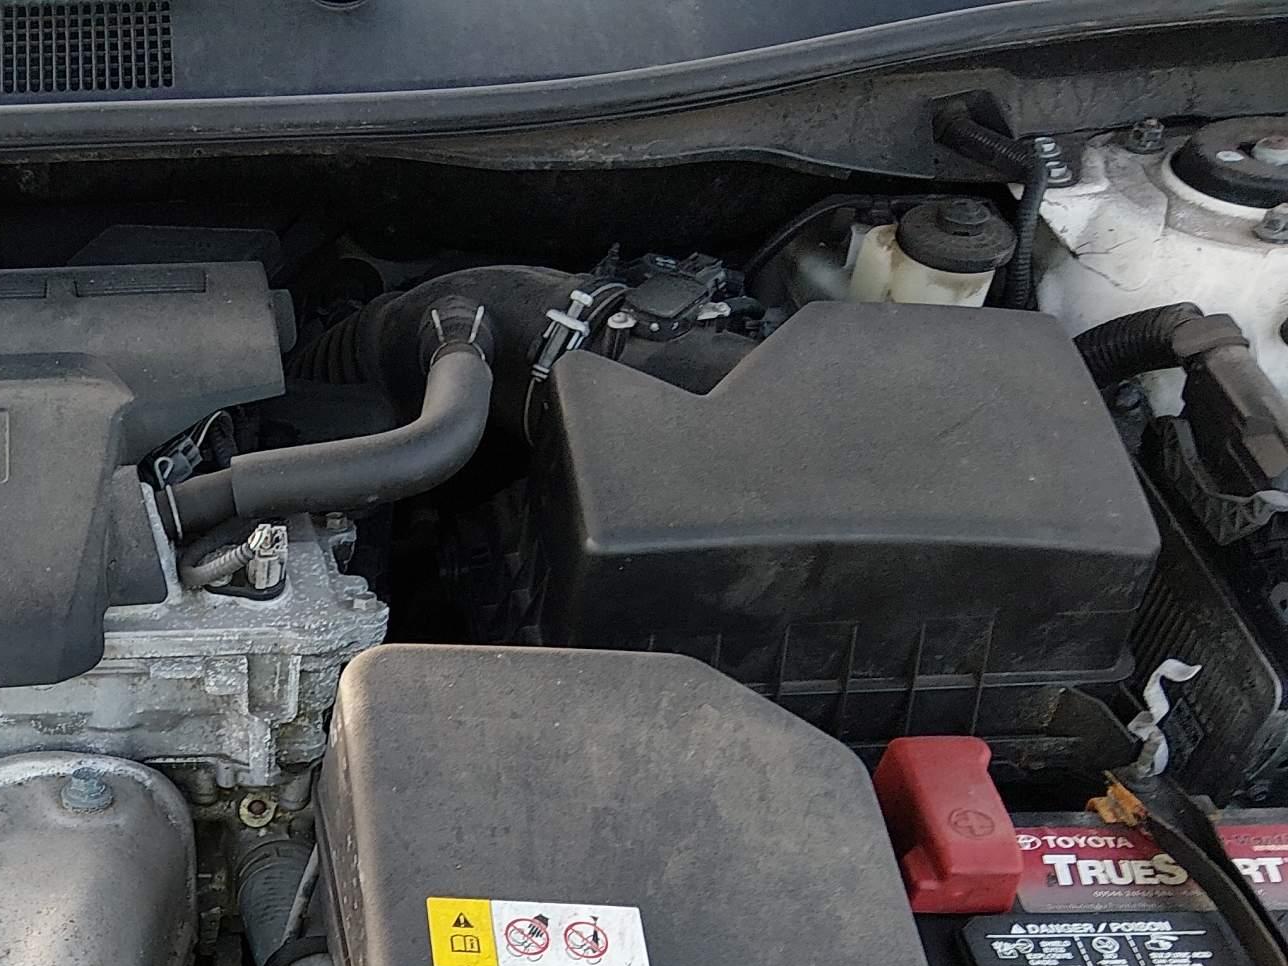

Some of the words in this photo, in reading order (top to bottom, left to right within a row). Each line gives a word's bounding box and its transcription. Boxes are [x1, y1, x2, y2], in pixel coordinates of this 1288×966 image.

[1043, 835, 1134, 849] TOYOTA
[1027, 922, 1095, 934] DANGER
[1110, 921, 1172, 932] POISON
